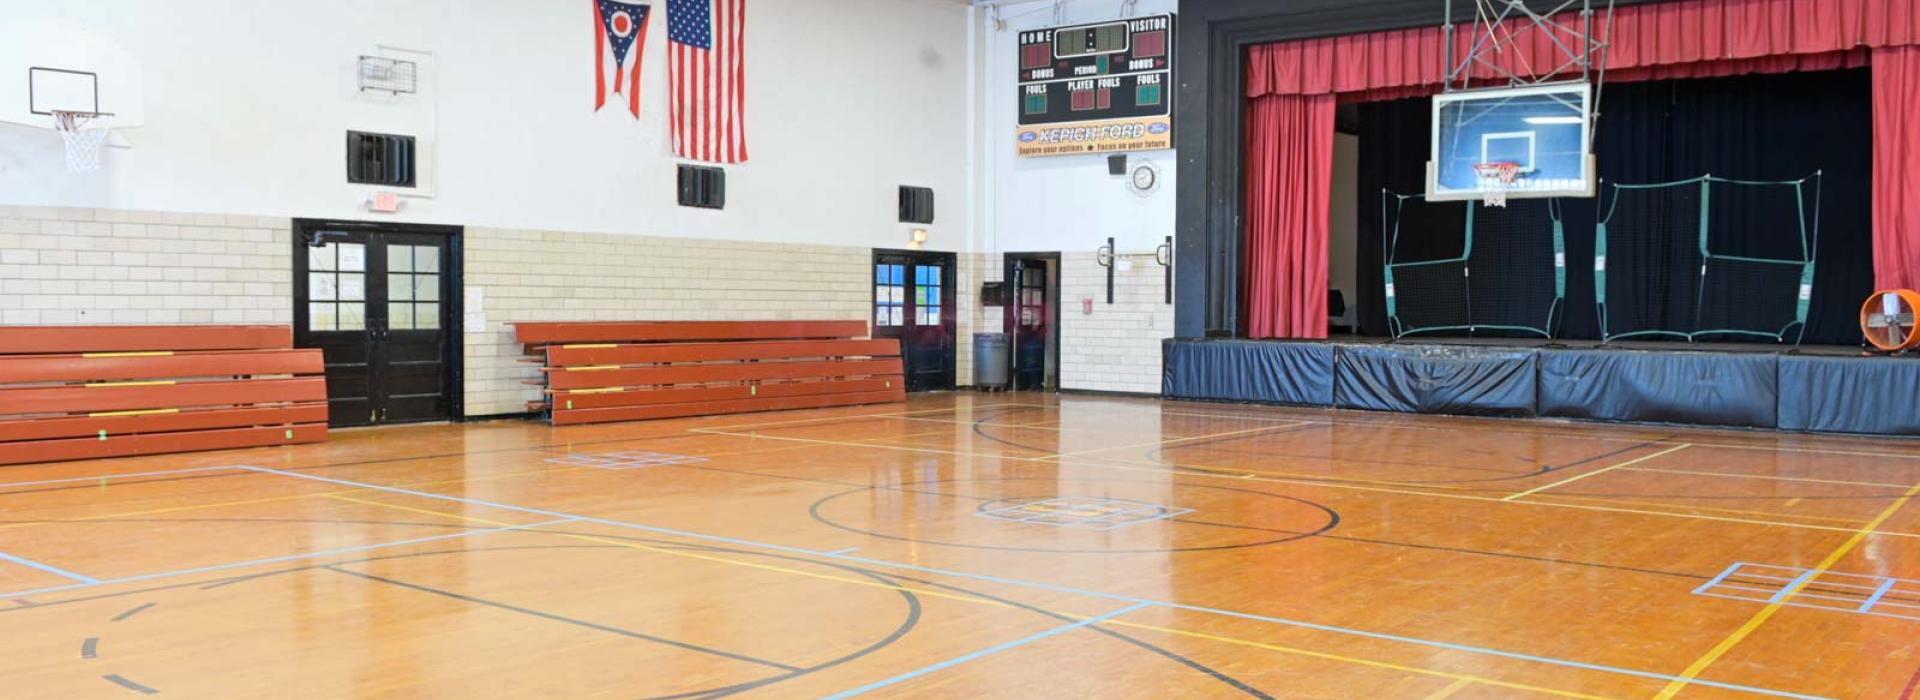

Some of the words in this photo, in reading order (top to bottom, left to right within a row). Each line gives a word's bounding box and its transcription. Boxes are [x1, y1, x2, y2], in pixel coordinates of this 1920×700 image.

[1130, 18, 1166, 32] VISITOR
[1021, 31, 1051, 44] HOME
[1075, 65, 1097, 75] PERIOD
[1129, 58, 1153, 70] BONUS
[1032, 68, 1054, 79] BONUS
[1137, 74, 1160, 84] FOULS
[1026, 84, 1047, 94] FOULS
[1068, 80, 1094, 91] PLAYER
[1098, 78, 1120, 88] FOULS
[1101, 123, 1145, 139] FORD
